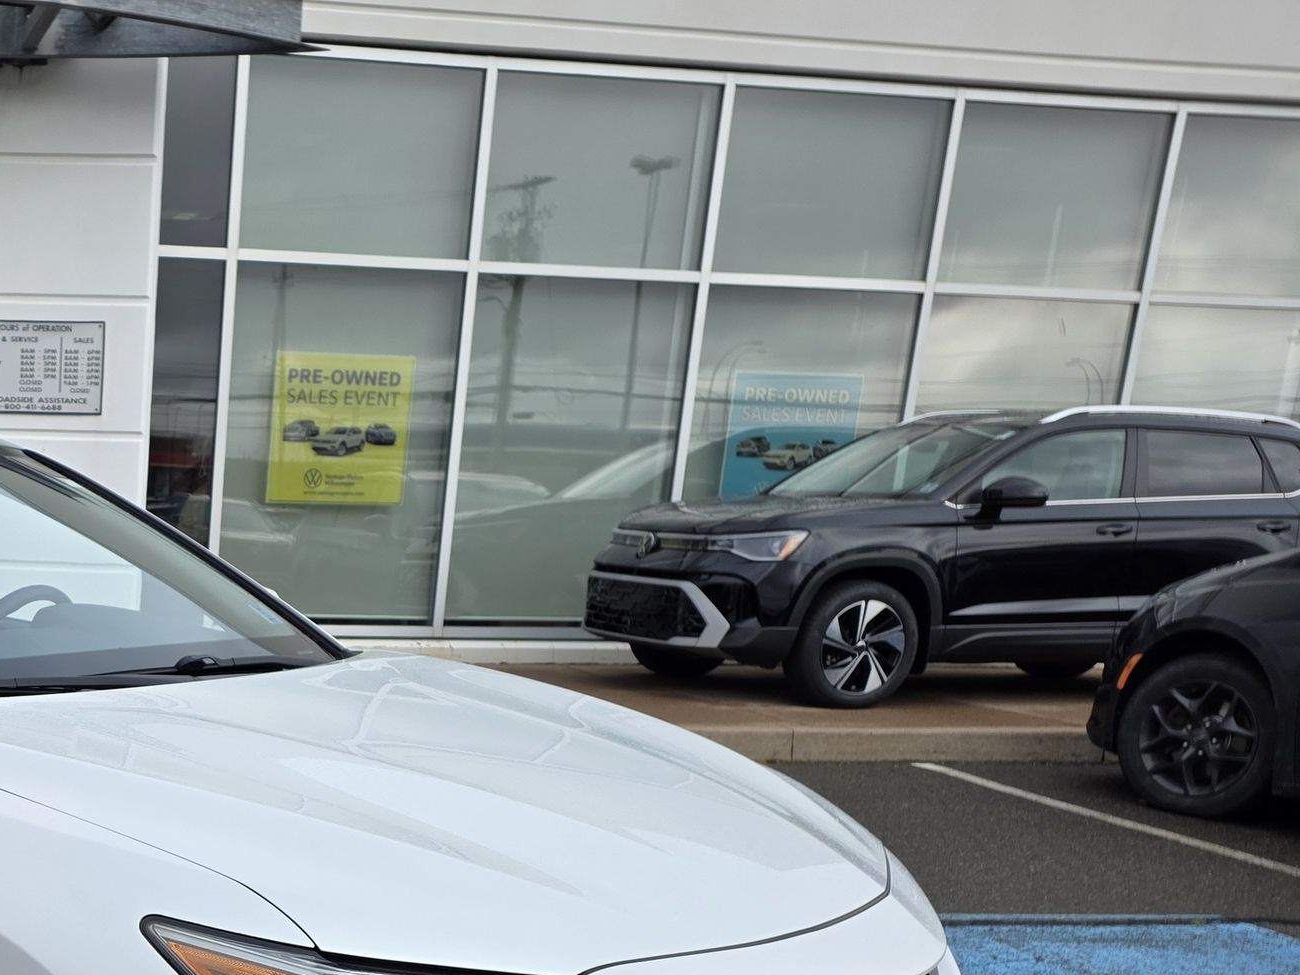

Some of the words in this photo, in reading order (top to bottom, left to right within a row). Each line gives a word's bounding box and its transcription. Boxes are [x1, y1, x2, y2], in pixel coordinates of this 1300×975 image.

[22, 323, 30, 331] of
[32, 324, 72, 332] OPERATION
[288, 368, 402, 387] PRE-OWNED
[287, 388, 338, 405] SALES
[343, 390, 400, 407] EVENT
[744, 387, 850, 403] PRE-OWNED
[742, 406, 792, 422] SALES
[795, 407, 845, 424] EVENT
